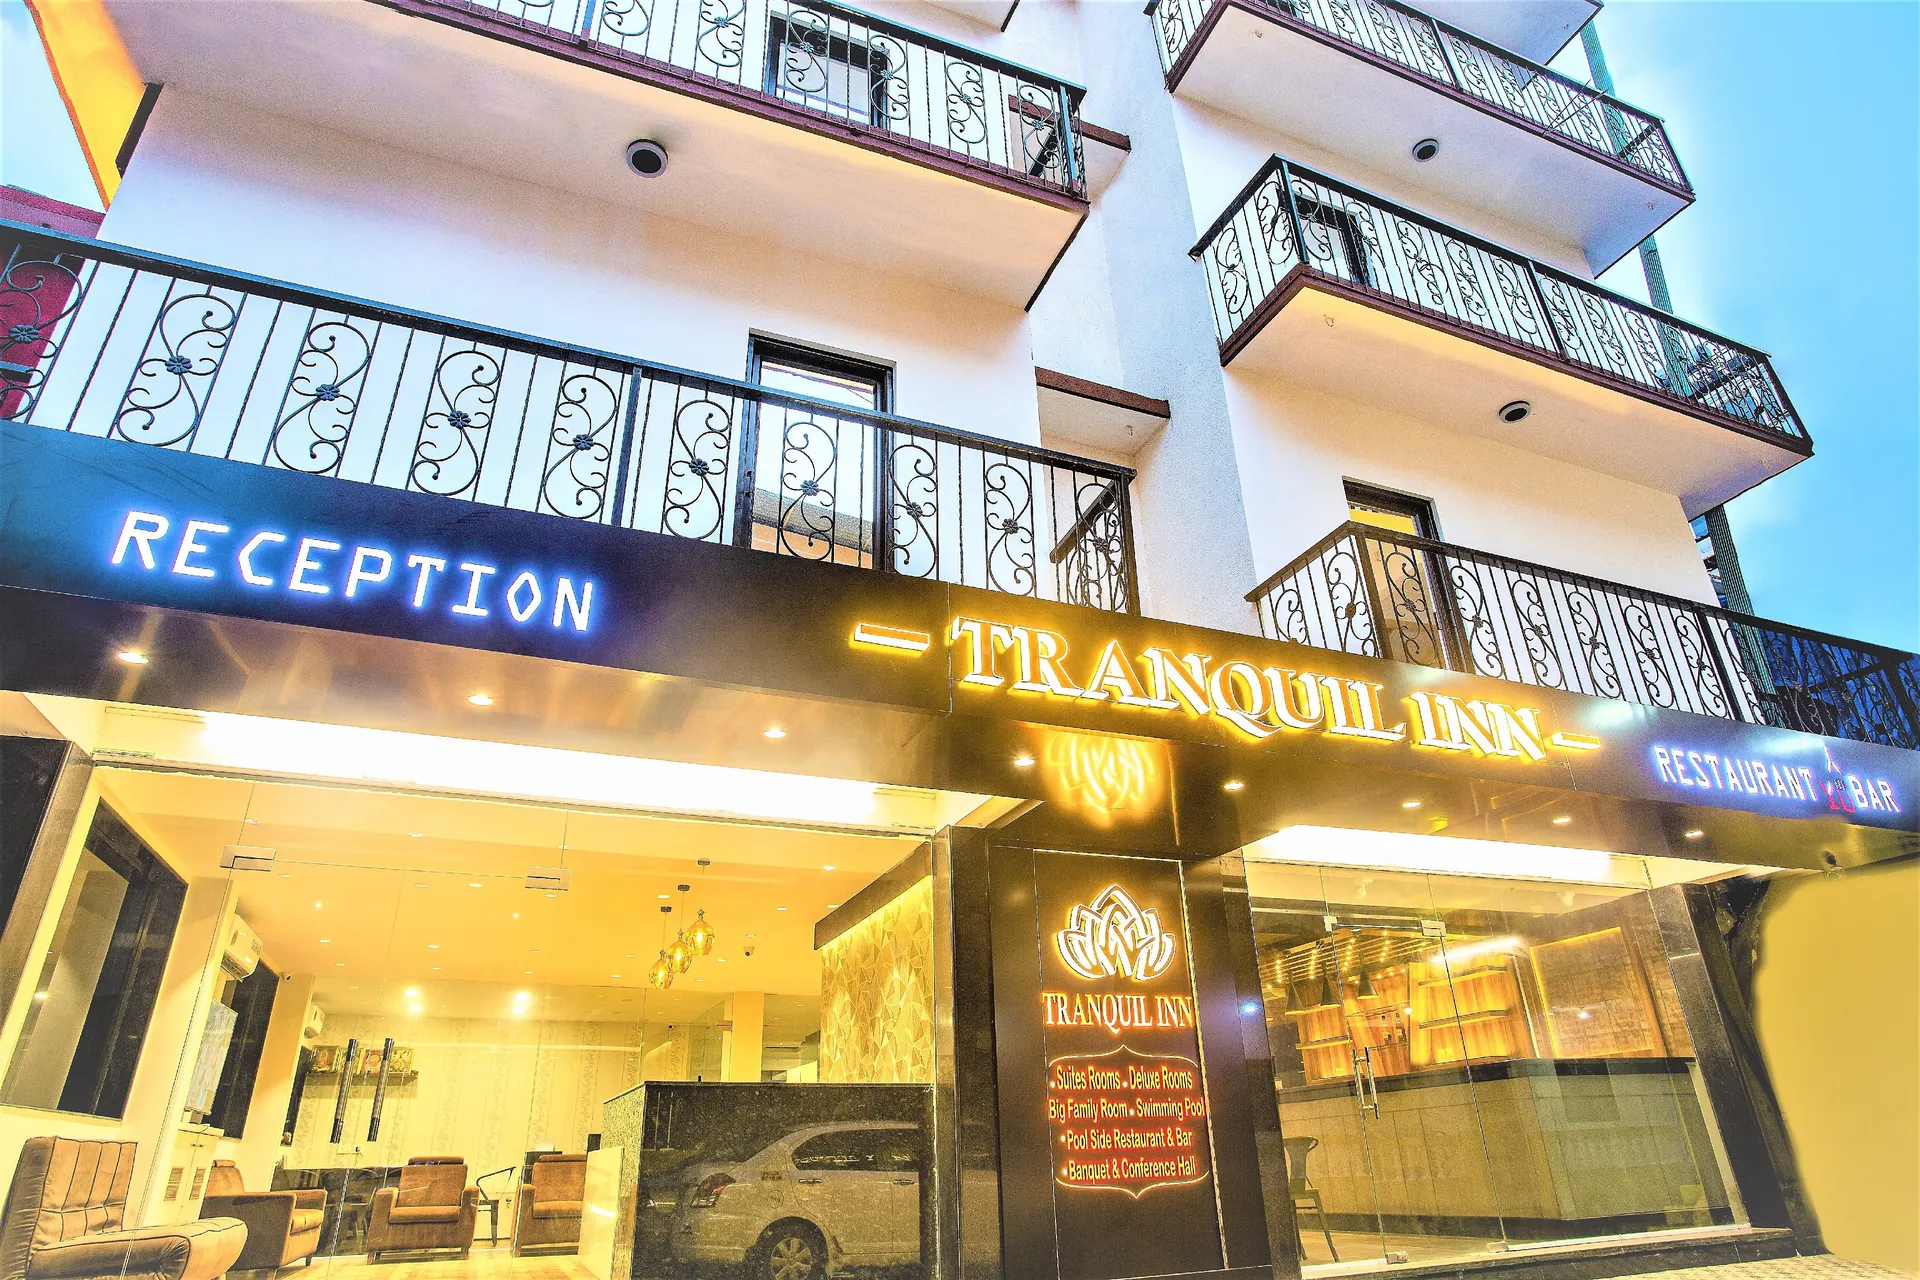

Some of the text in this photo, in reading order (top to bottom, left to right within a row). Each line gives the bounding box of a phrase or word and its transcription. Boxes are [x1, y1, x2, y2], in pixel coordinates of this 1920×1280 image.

[111, 510, 593, 631] RECEPTION
[951, 616, 1548, 761] TRANQUIL INN
[1654, 746, 1900, 812] RESTAURANT BAR
[1042, 992, 1193, 1034] TRANQUIL INN
[1056, 1065, 1192, 1090] Suites Rooms Deluxe Rooms
[1049, 1097, 1205, 1123] Big Family Room Swimming Pool
[1067, 1127, 1193, 1150] Pool Side Restaurant & Bar
[1068, 1155, 1196, 1185] Banquet & Conference Hall
